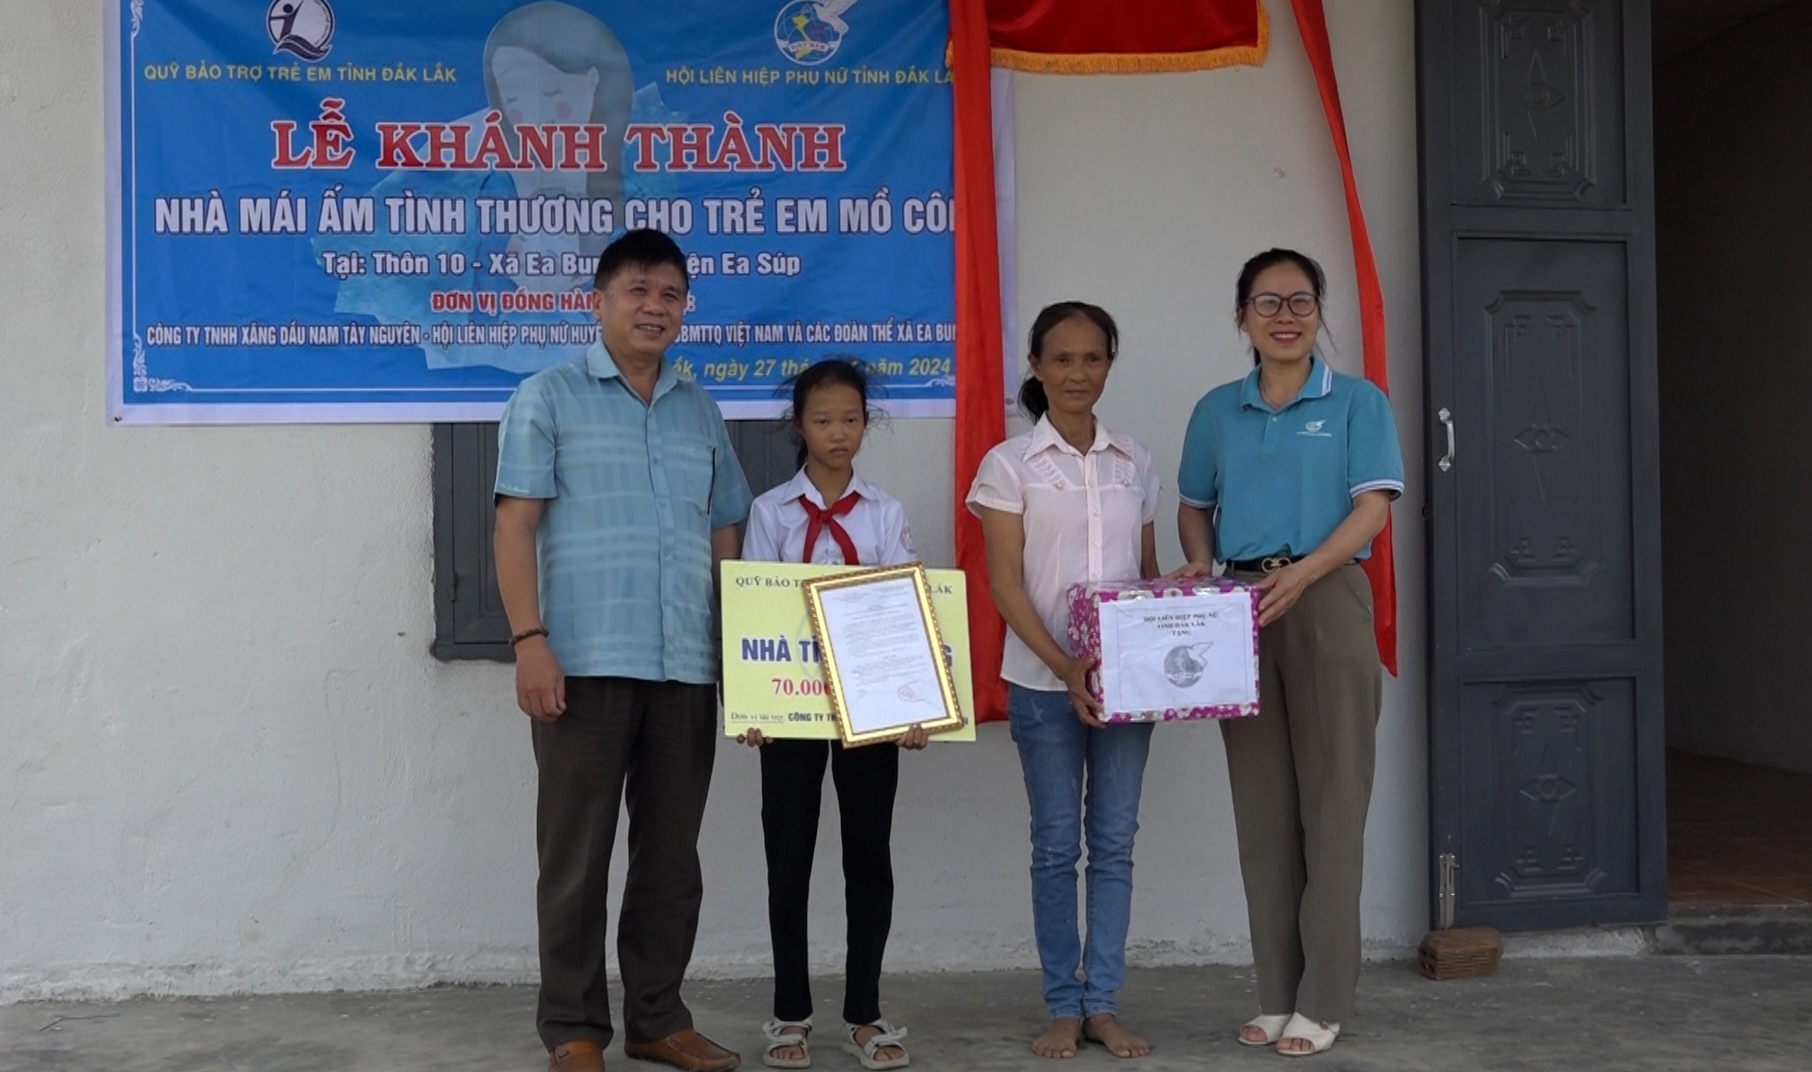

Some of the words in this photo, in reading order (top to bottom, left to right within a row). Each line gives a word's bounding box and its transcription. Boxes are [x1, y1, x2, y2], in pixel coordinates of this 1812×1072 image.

[144, 61, 180, 80] QUỸ
[185, 59, 222, 80] BẢO
[226, 64, 262, 83] TRỢ
[267, 61, 302, 81] TRẺ
[306, 66, 332, 81] EM
[336, 62, 376, 81] TỈNH
[381, 62, 417, 82] ĐẮK
[423, 62, 457, 82] LẮK
[666, 65, 694, 86] HỘI
[700, 65, 737, 85] LIÊN
[742, 66, 780, 87] HIỆP
[786, 70, 819, 87] PHỤ
[825, 67, 848, 84] NỮ
[852, 65, 890, 84] TỈNH
[895, 65, 929, 84] ĐẮK
[271, 98, 354, 168] LỄ
[376, 110, 607, 171] KHÁNH
[624, 110, 847, 171] THÀNH
[154, 189, 229, 233] NHÀ
[239, 189, 307, 233] MÁI
[317, 183, 374, 233] ẤM
[385, 190, 466, 233] TÌNH
[476, 196, 614, 233] THƯƠNG
[624, 199, 693, 233] CHO
[702, 187, 765, 234] TRẺ
[776, 198, 828, 233] EM
[323, 252, 364, 278] Tại:
[373, 252, 428, 273] Thôn
[438, 253, 465, 273] 10
[490, 252, 519, 273] Xã
[527, 253, 554, 273] Ea
[721, 253, 750, 274] Ea
[757, 252, 800, 276] Súp
[431, 290, 473, 312] ĐƠN
[477, 291, 497, 316] VỊ
[146, 322, 182, 346] CÔNG
[185, 326, 200, 345] TY
[204, 326, 238, 345] TNHH
[241, 322, 277, 346] XĂNG
[309, 326, 339, 345] NAM
[342, 322, 366, 345] TÂY
[369, 322, 420, 346] NGUYÊN
[432, 322, 454, 347] HỘI
[457, 322, 485, 344] LIÊN
[488, 322, 517, 348] HIỆP
[520, 325, 547, 348] PHỤ
[725, 321, 751, 348] VIỆT
[755, 325, 784, 342] NAM
[787, 321, 803, 342] VÀ
[806, 322, 830, 342] CÁC
[834, 322, 868, 342] ĐOÀN
[897, 321, 914, 342] XÃ
[916, 325, 933, 341] EA
[703, 358, 749, 382] ngày
[753, 359, 777, 377] 27
[909, 358, 951, 376] 2024
[736, 576, 761, 588] QUỸ
[741, 634, 792, 662] NHÀ
[788, 711, 812, 722] CÔNG
[814, 713, 824, 722] TY
